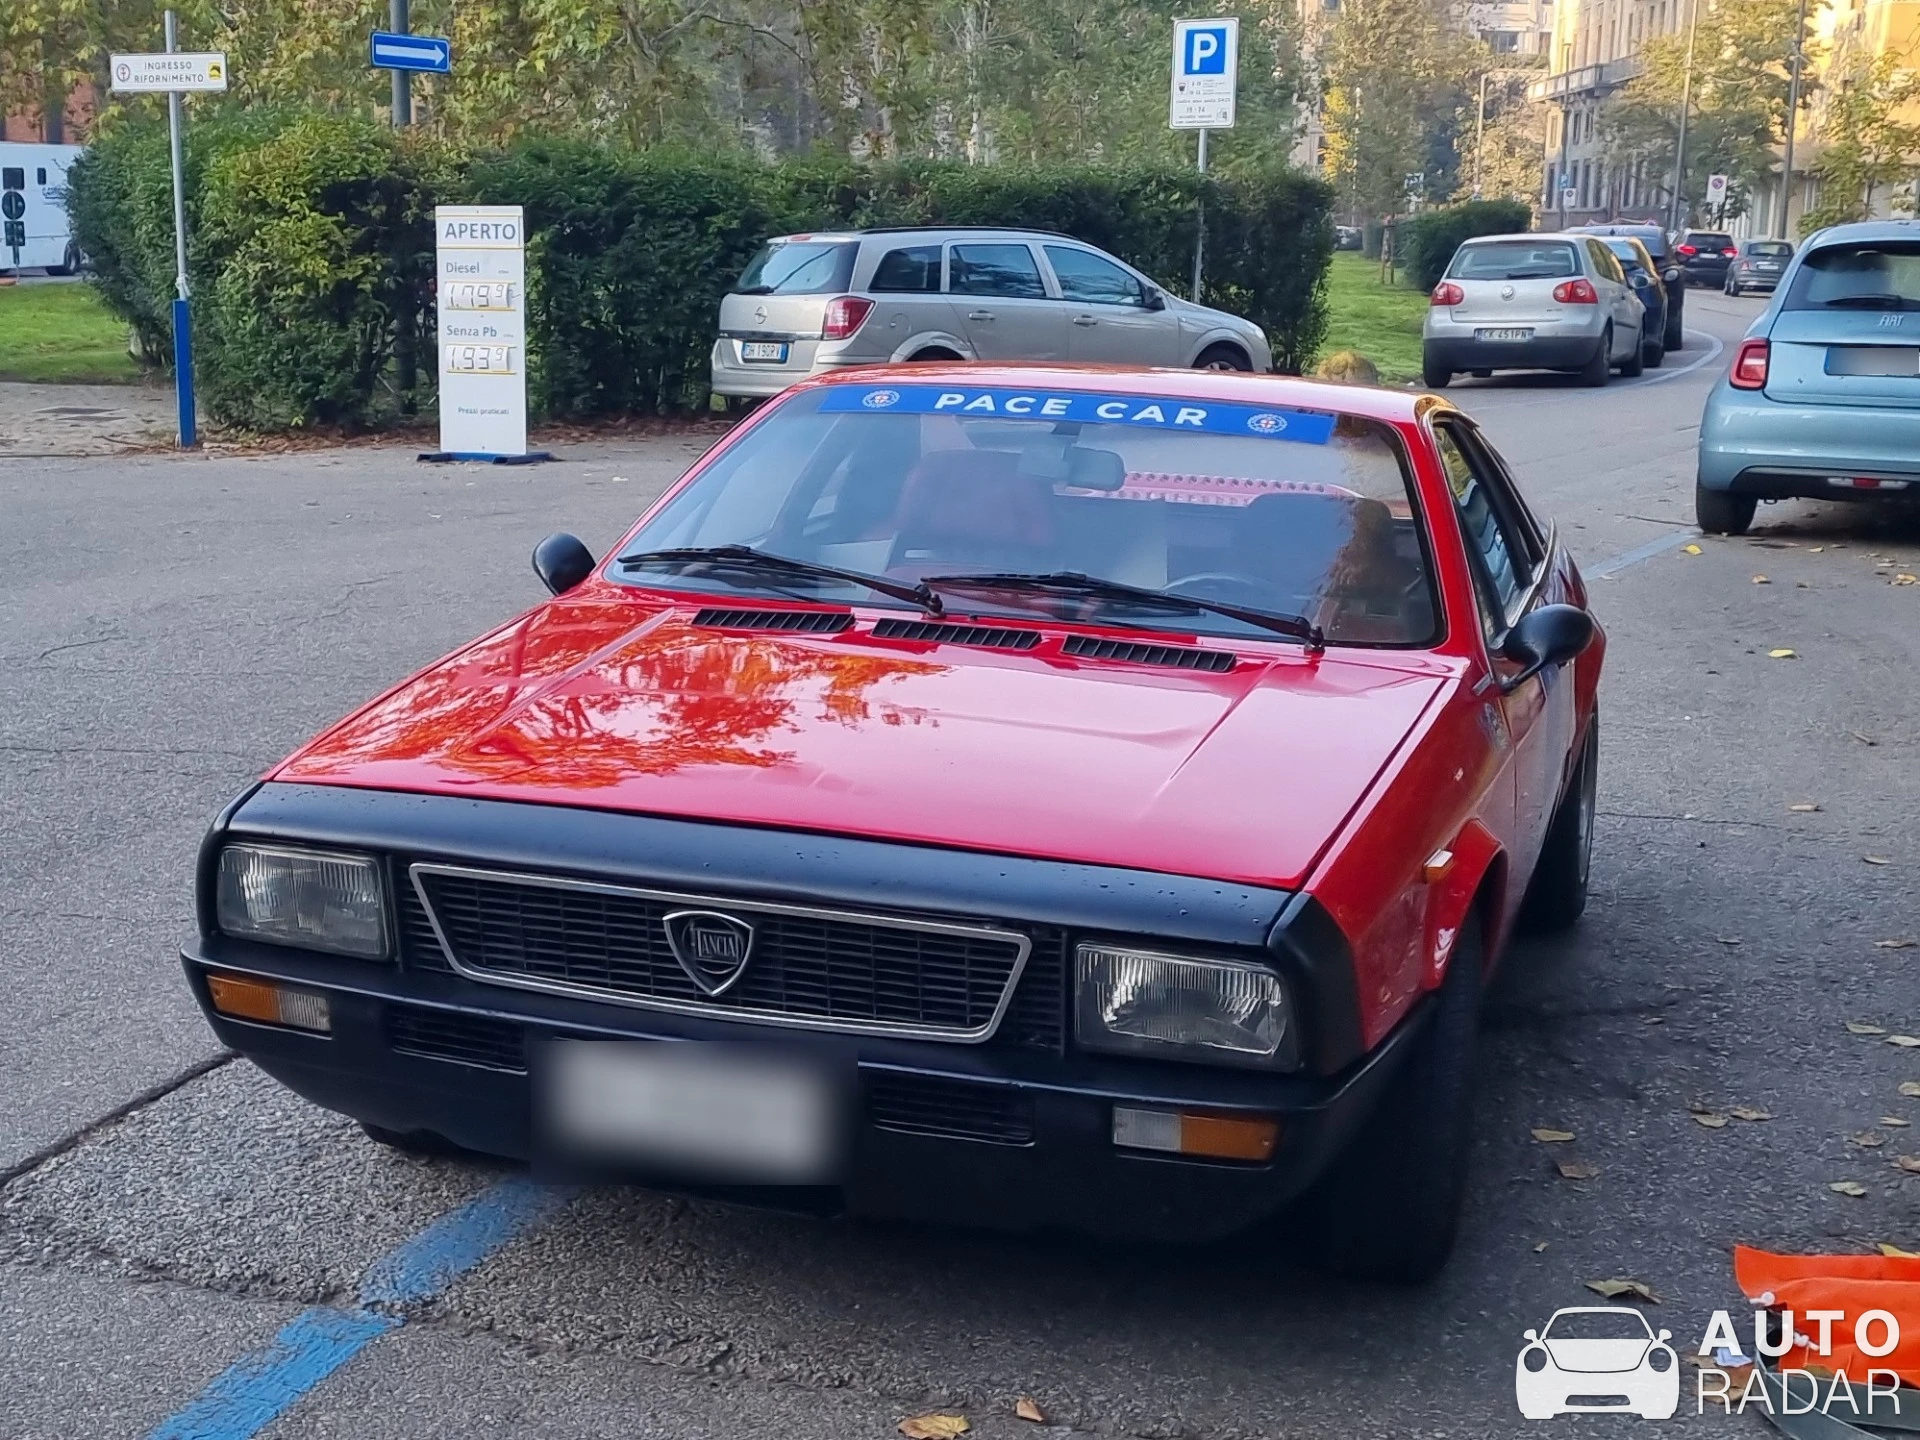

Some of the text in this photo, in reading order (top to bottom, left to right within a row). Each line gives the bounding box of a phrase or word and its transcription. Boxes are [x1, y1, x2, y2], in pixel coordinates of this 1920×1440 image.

[1192, 32, 1218, 71] P
[144, 61, 192, 70] INGRESSO
[134, 73, 204, 83] RIFORNIMENTO
[445, 222, 516, 240] APERTO
[446, 261, 480, 273] Diesel
[446, 325, 479, 337] Senza
[482, 326, 497, 337] Pb
[934, 393, 1207, 426] PACE CAR
[696, 929, 737, 958] LANCIA
